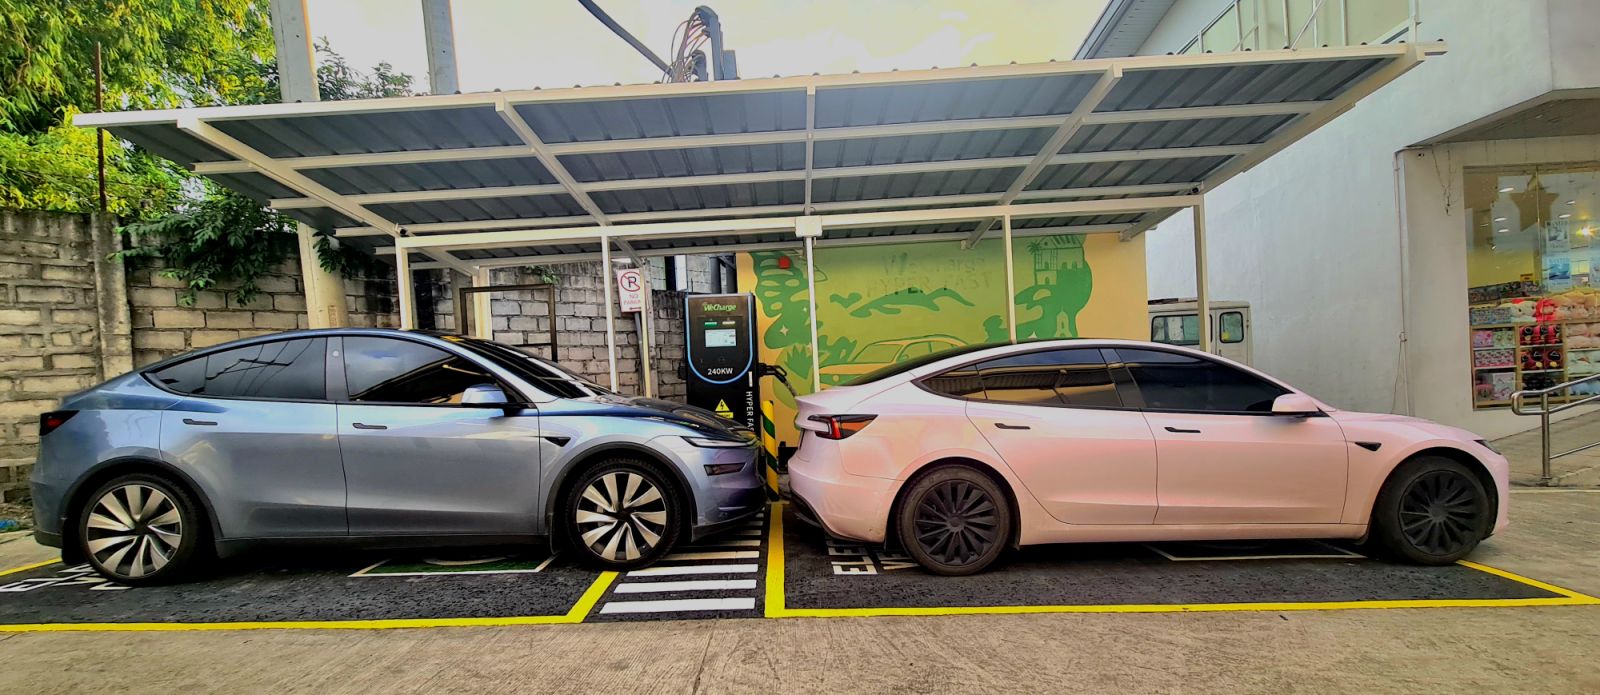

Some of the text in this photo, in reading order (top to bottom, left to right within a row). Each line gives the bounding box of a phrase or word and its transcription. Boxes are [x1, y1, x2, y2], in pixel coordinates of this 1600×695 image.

[704, 303, 736, 312] WeCharge
[707, 367, 734, 376] 240KW
[745, 391, 754, 416] HYPER
